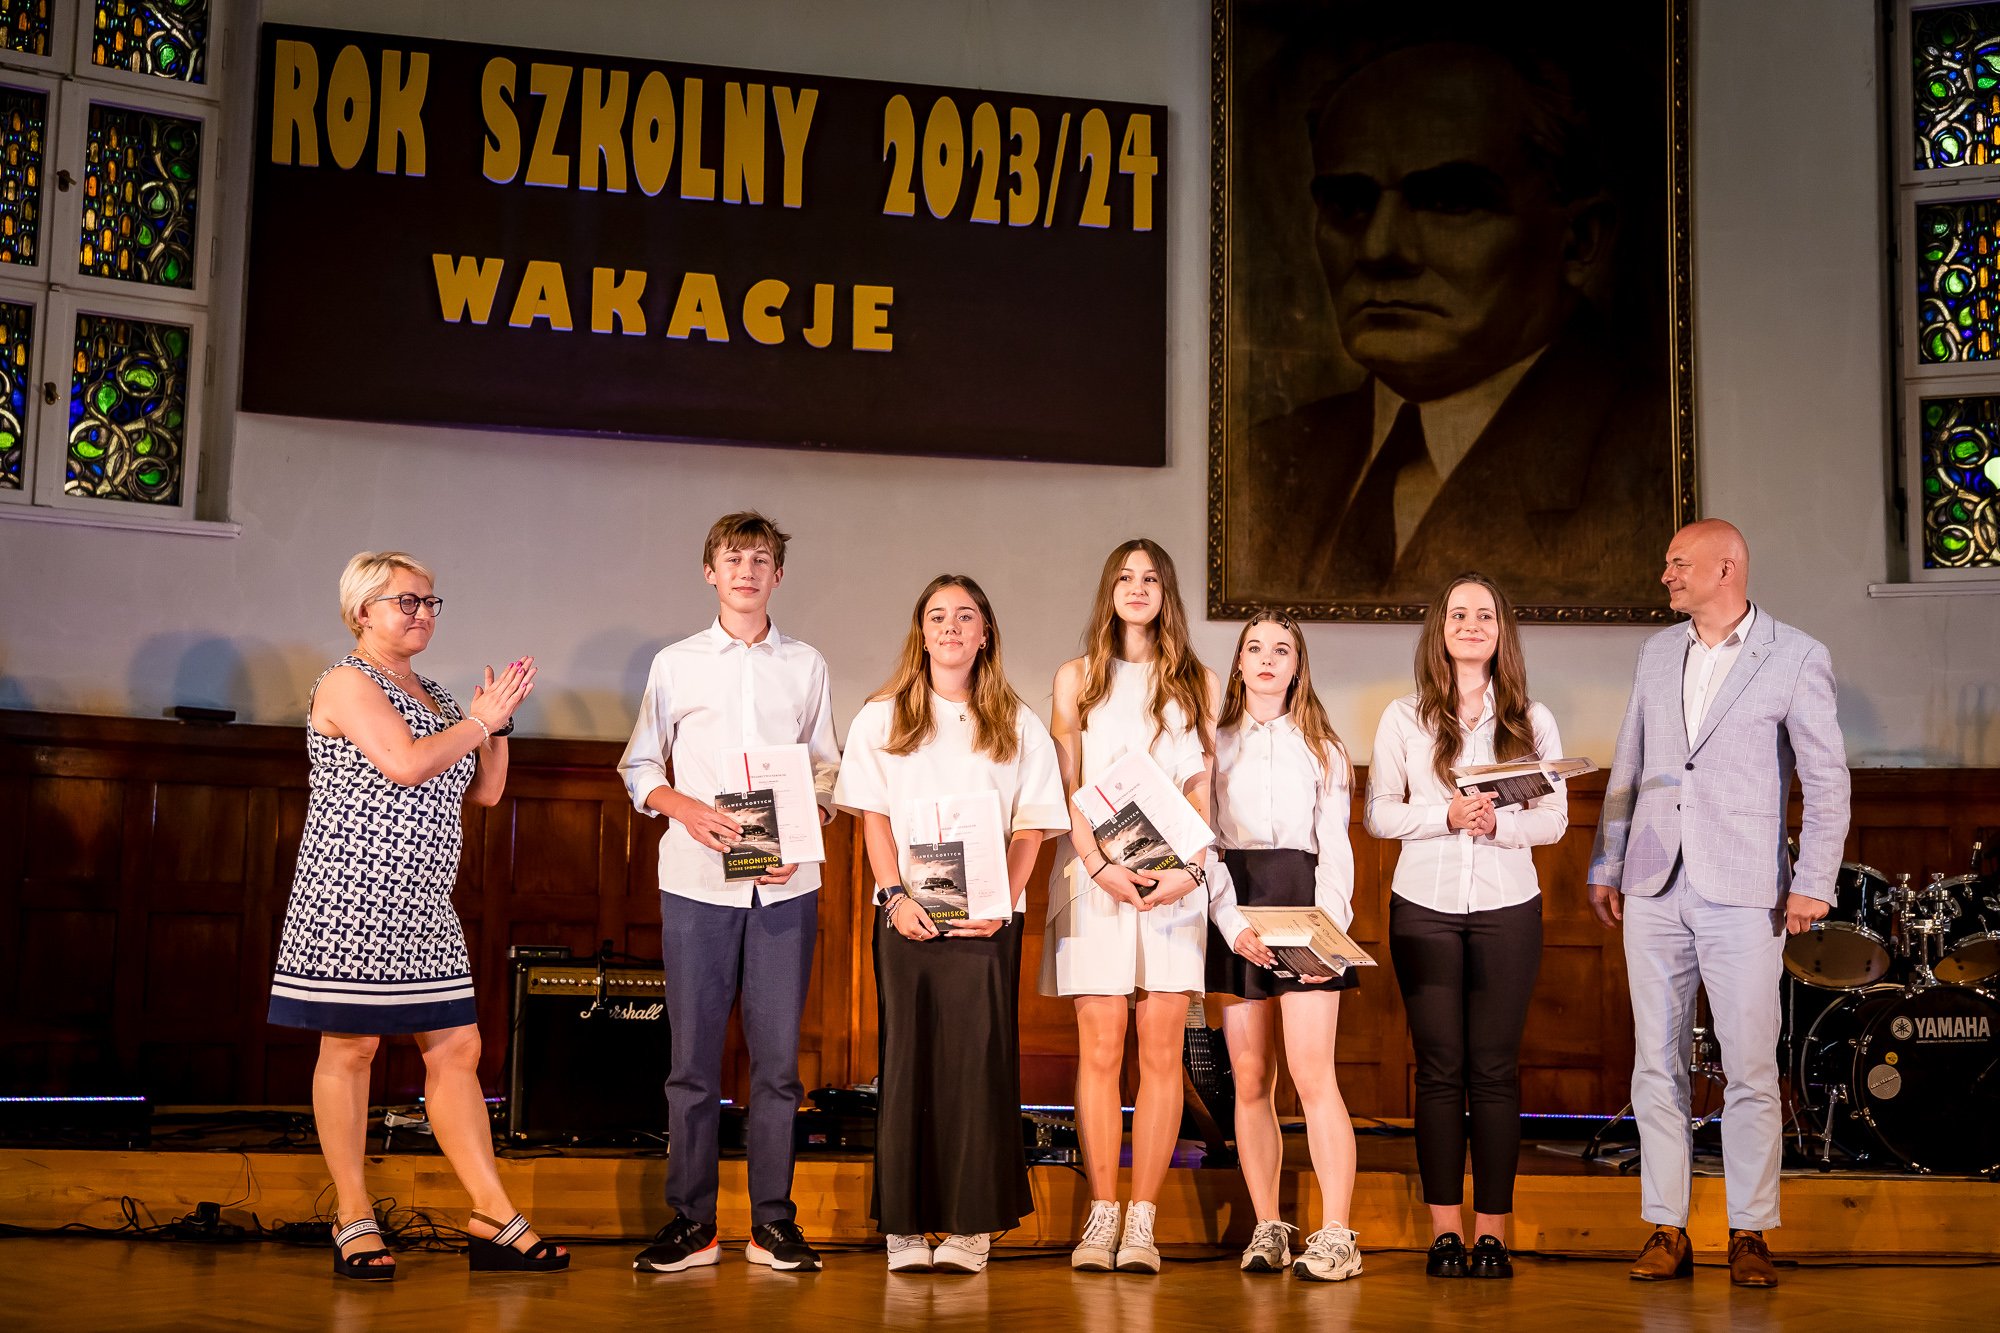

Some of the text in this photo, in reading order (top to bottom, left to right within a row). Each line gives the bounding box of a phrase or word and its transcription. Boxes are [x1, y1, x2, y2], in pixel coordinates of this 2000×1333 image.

[272, 39, 1158, 231] ROK SZKOLNY 2023/24
[432, 253, 894, 352] WAKACJE
[727, 855, 779, 867] SCHRONISKO
[1914, 1016, 1991, 1038] YAMAHA
